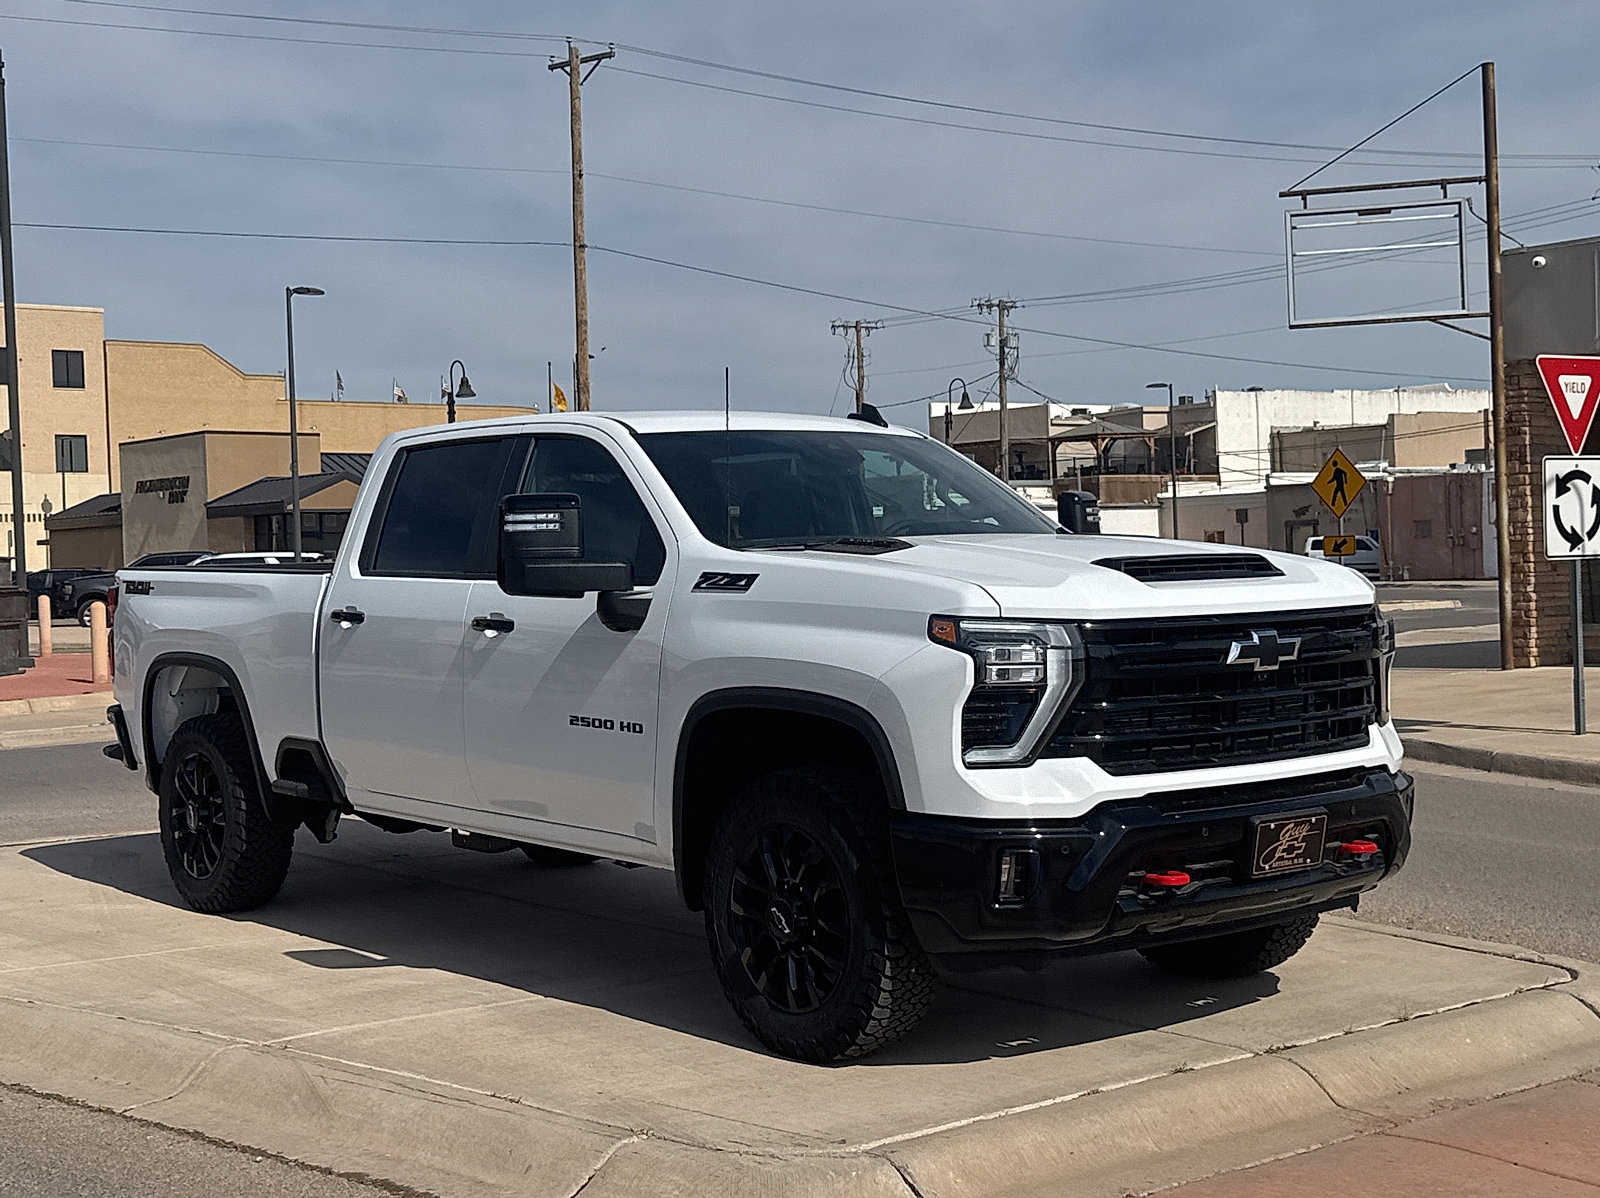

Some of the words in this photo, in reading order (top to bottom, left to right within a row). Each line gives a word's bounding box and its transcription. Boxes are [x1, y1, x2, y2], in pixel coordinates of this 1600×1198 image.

[1564, 381, 1586, 394] YIELD
[691, 571, 760, 593] Z71
[569, 715, 615, 731] 2500
[619, 720, 644, 734] HD
